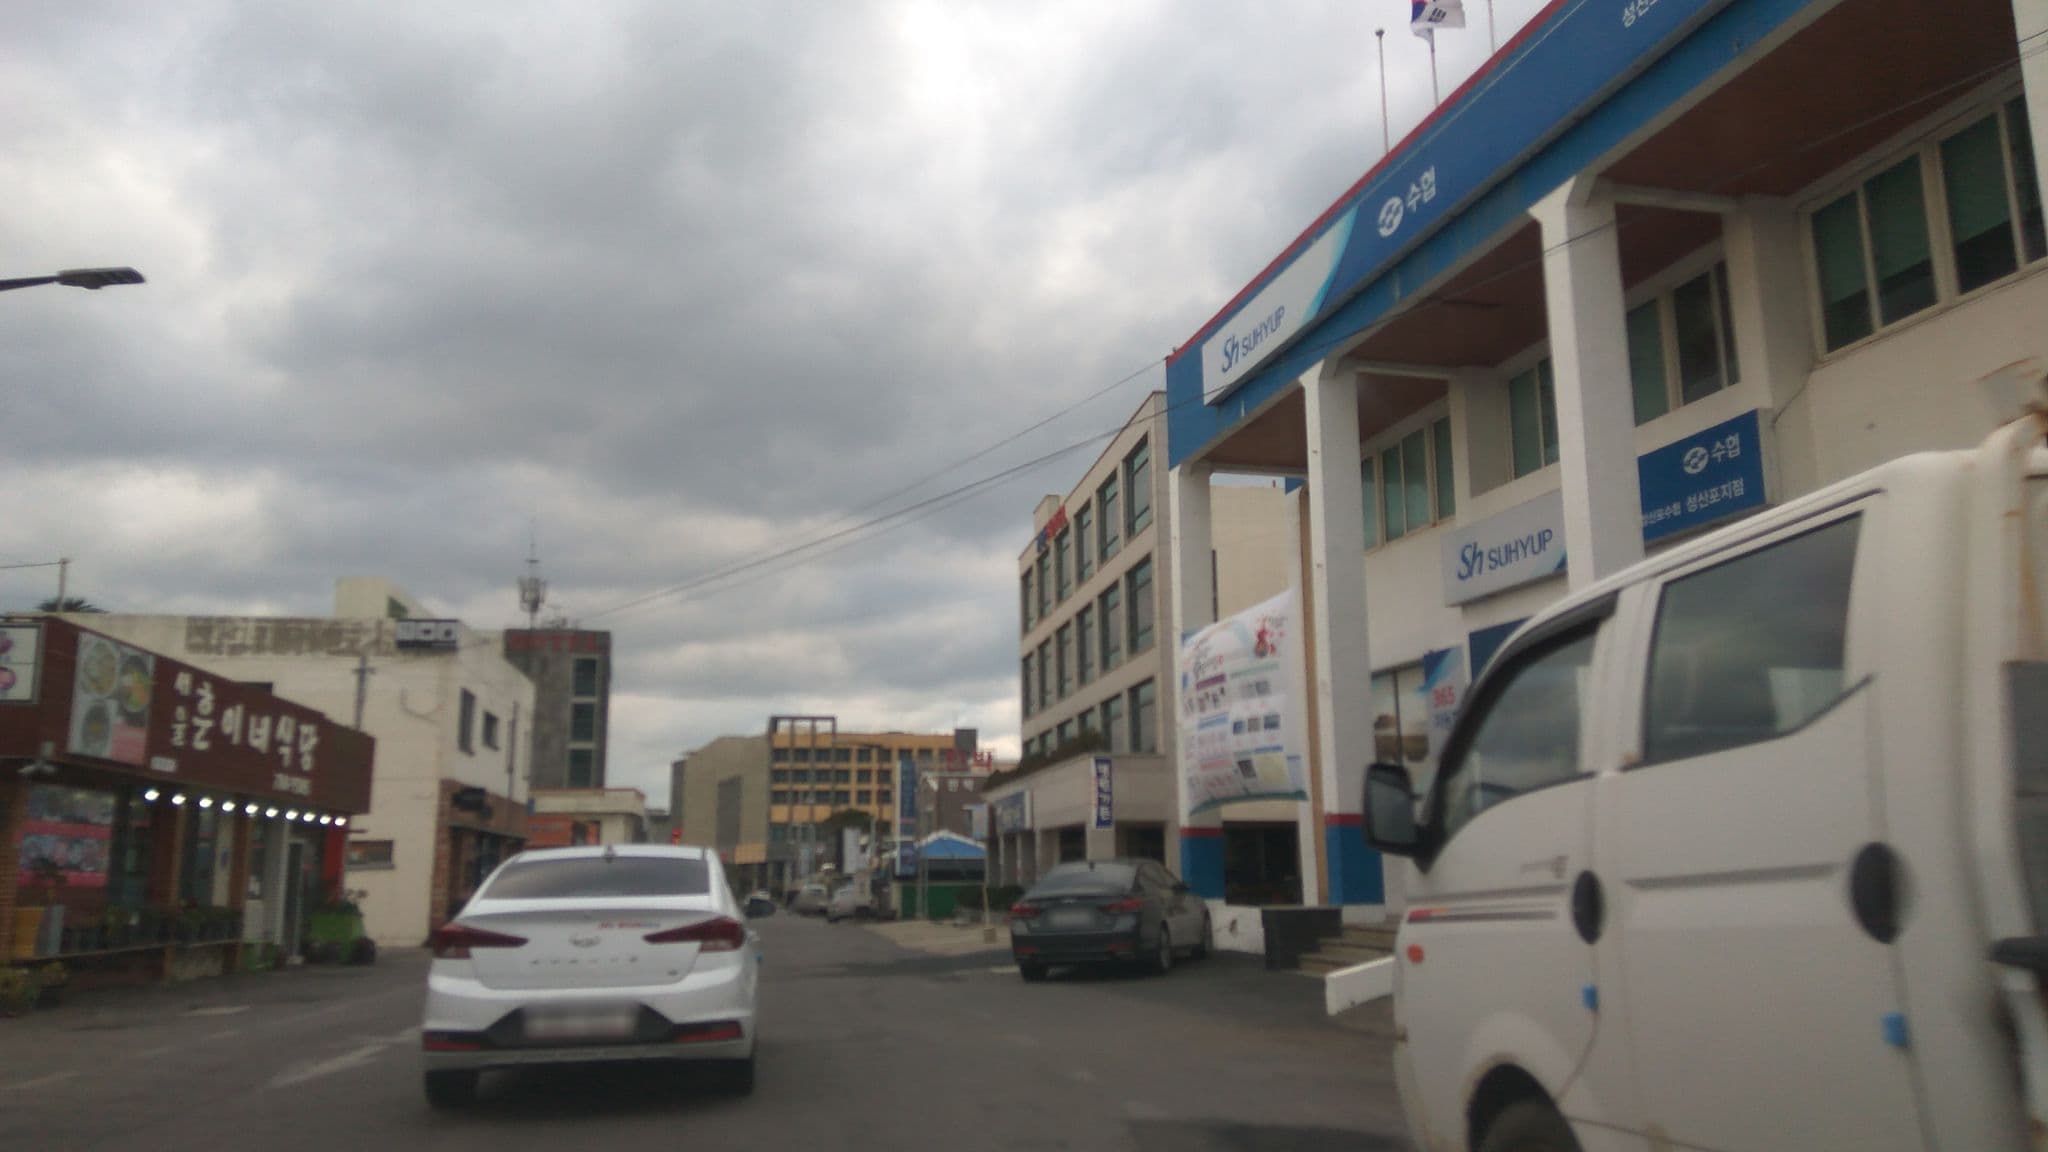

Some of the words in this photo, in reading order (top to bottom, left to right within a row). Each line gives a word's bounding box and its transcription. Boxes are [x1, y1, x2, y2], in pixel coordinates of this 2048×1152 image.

[1407, 166, 1436, 211] 수협
[1222, 333, 1240, 374] Sh
[1242, 306, 1285, 357] SUHYUP
[1711, 432, 1741, 462] 수협
[1687, 478, 1744, 512] 성산포지점
[1458, 542, 1484, 580] Sh
[1488, 529, 1553, 571] SUHYUP
